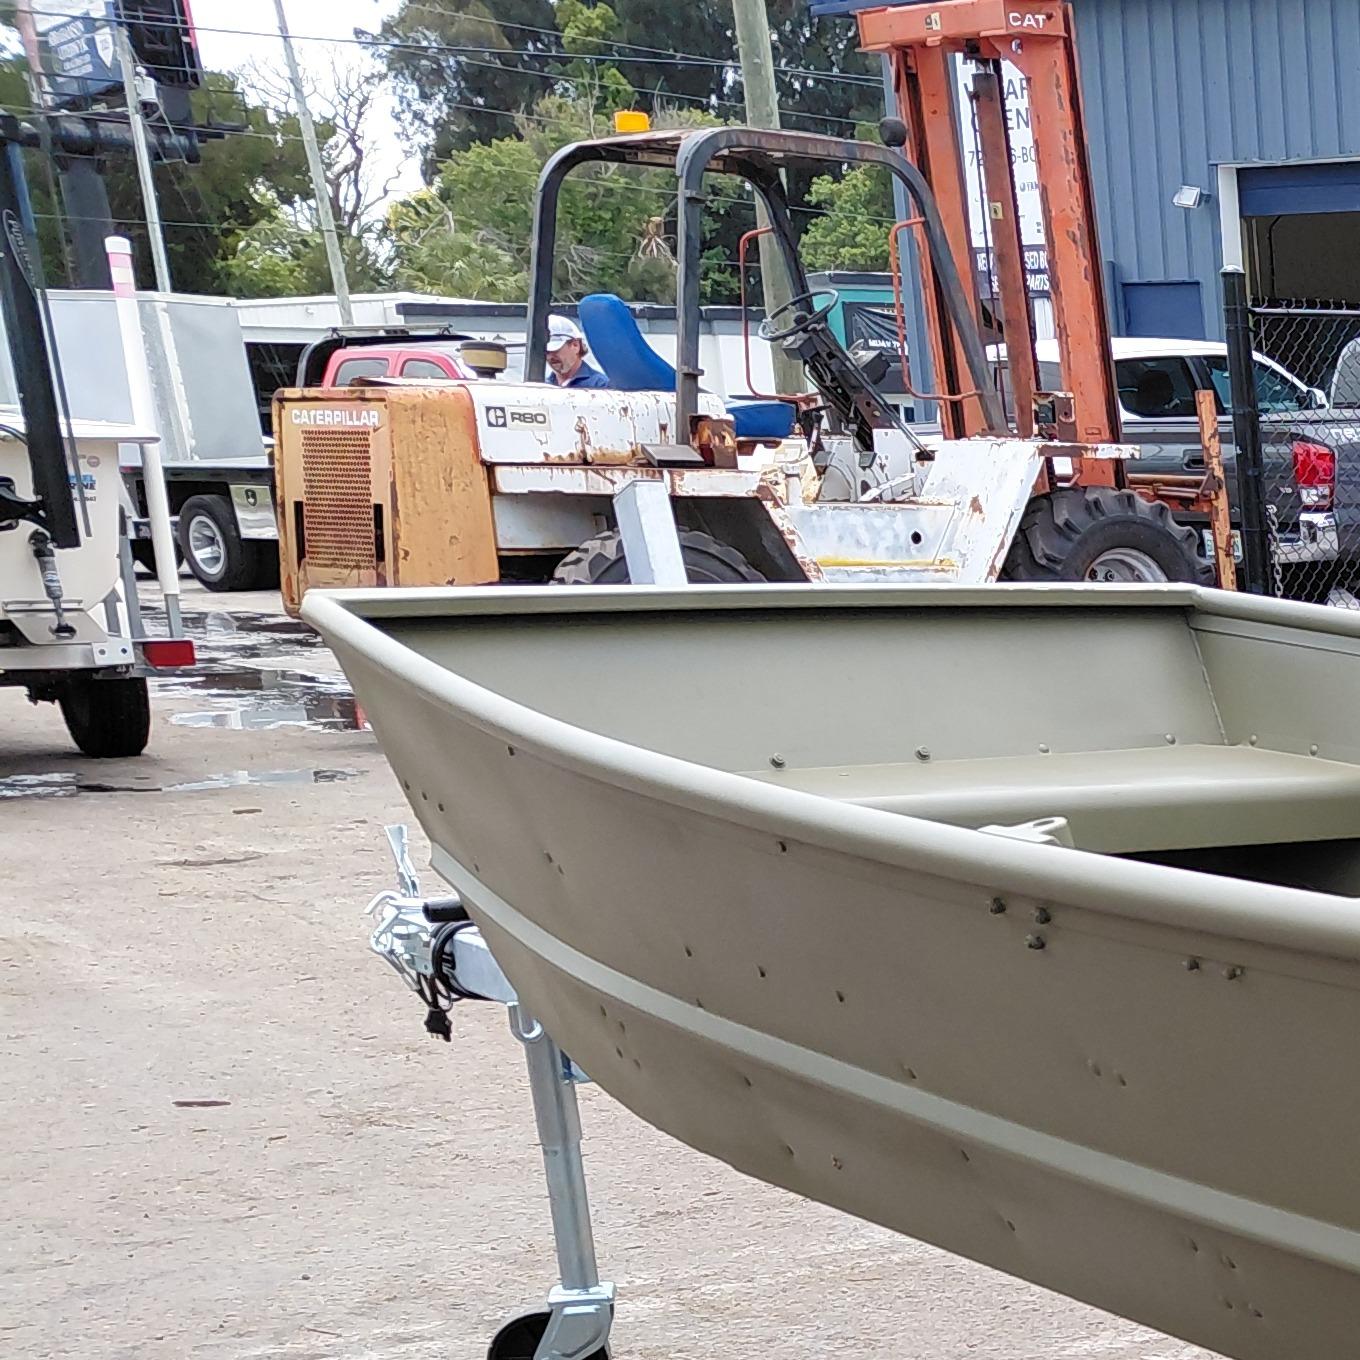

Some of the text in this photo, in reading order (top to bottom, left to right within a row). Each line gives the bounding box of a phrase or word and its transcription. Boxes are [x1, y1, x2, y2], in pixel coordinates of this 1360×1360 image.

[1008, 12, 1047, 29] CAT
[291, 409, 380, 427] CATERPILLAR
[510, 411, 548, 425] R80
